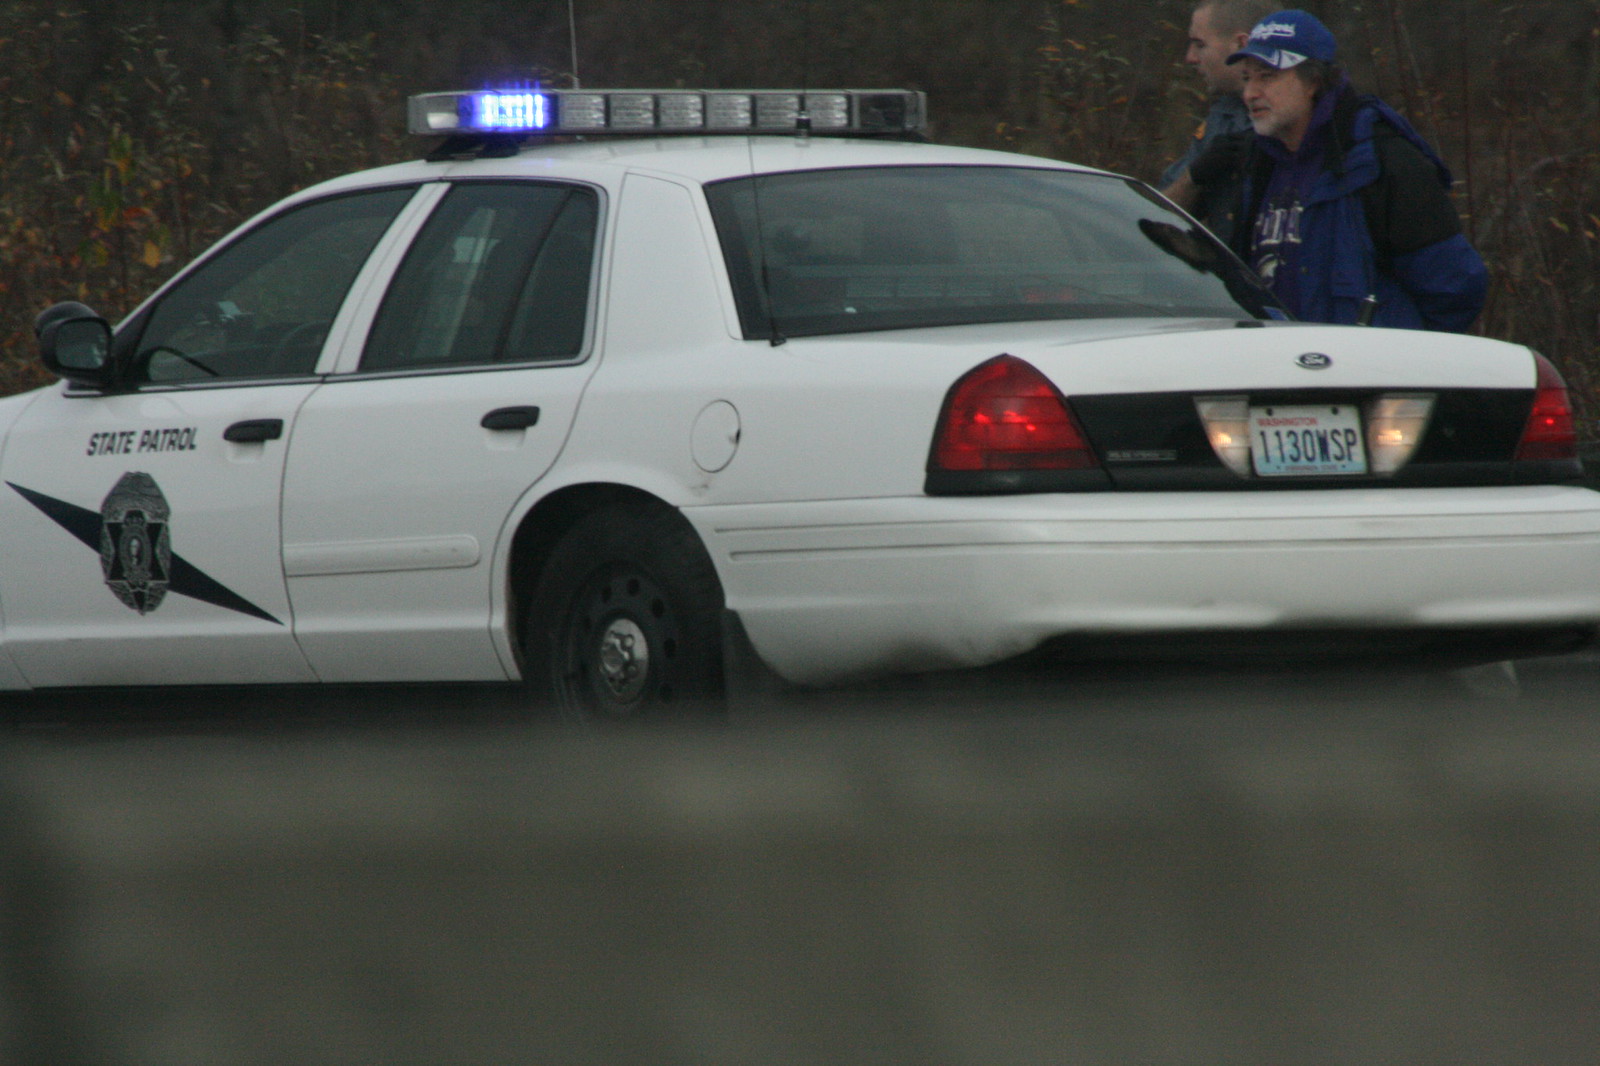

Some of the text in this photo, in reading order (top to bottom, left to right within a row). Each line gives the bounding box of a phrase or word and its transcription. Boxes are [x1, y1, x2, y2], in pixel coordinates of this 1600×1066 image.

[86, 427, 198, 456] STATE PATROL
[1259, 428, 1357, 463] 1130WSP
